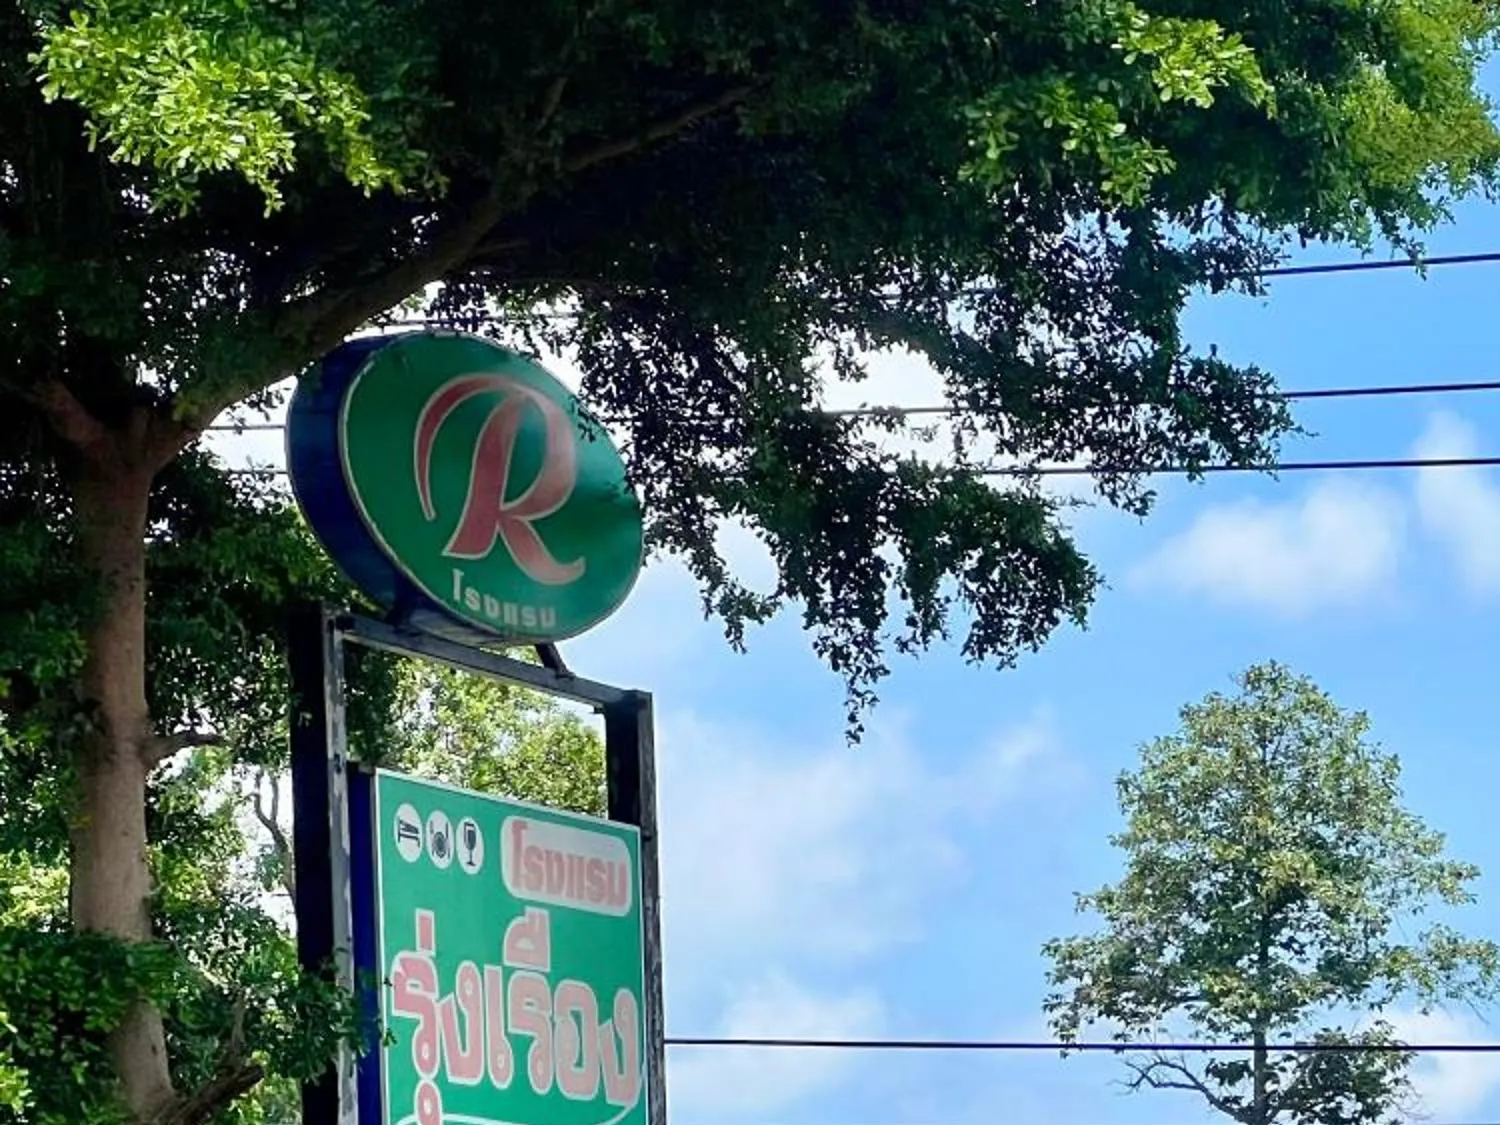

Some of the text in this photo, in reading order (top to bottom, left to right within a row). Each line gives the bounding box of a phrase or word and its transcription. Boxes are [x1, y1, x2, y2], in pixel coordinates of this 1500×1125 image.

[413, 373, 586, 586] R
[452, 568, 556, 629] โรงแรม
[511, 819, 628, 907] โรงแรม
